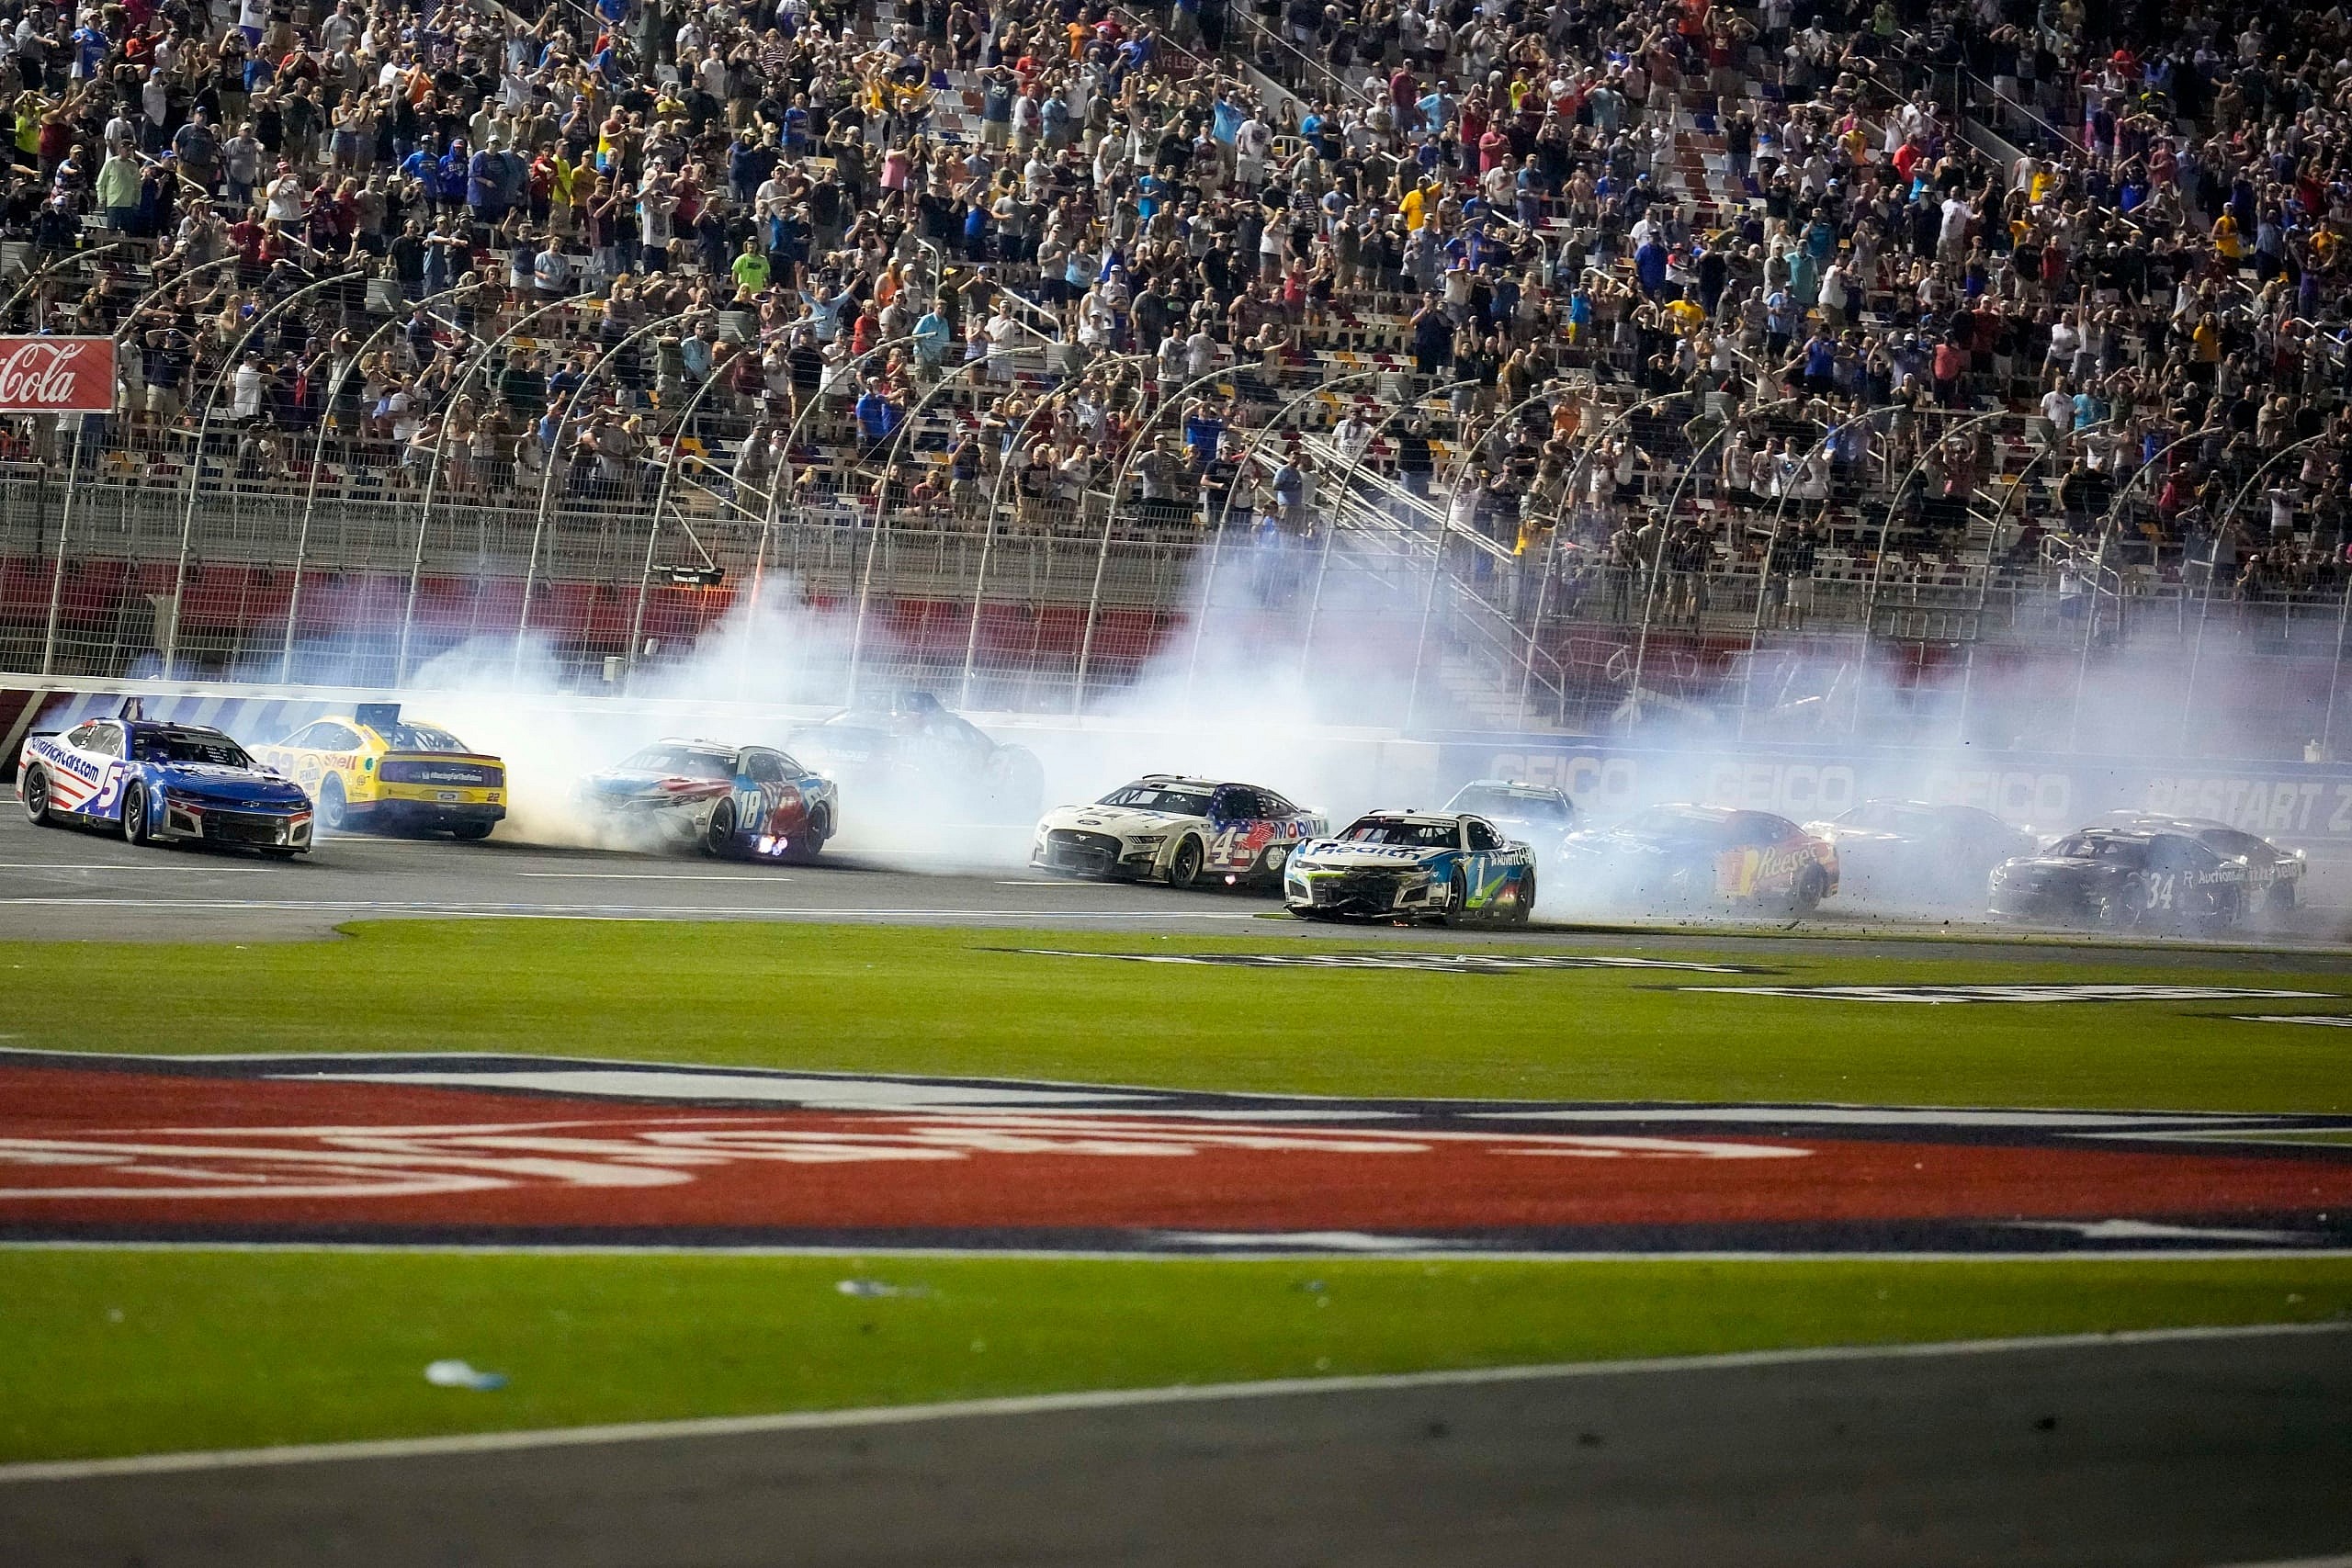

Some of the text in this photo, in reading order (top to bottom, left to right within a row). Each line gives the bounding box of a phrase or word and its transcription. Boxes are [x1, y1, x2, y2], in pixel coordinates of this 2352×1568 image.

[0, 343, 86, 402] Cola
[324, 754, 357, 771] Shell
[98, 765, 125, 808] 5
[486, 792, 501, 803] 22
[1707, 761, 1854, 812] GEICO
[741, 791, 762, 829] 18
[1212, 824, 1238, 864] 4
[1311, 842, 1420, 861] Health
[1476, 856, 1486, 897] 1
[2146, 872, 2176, 910] 34
